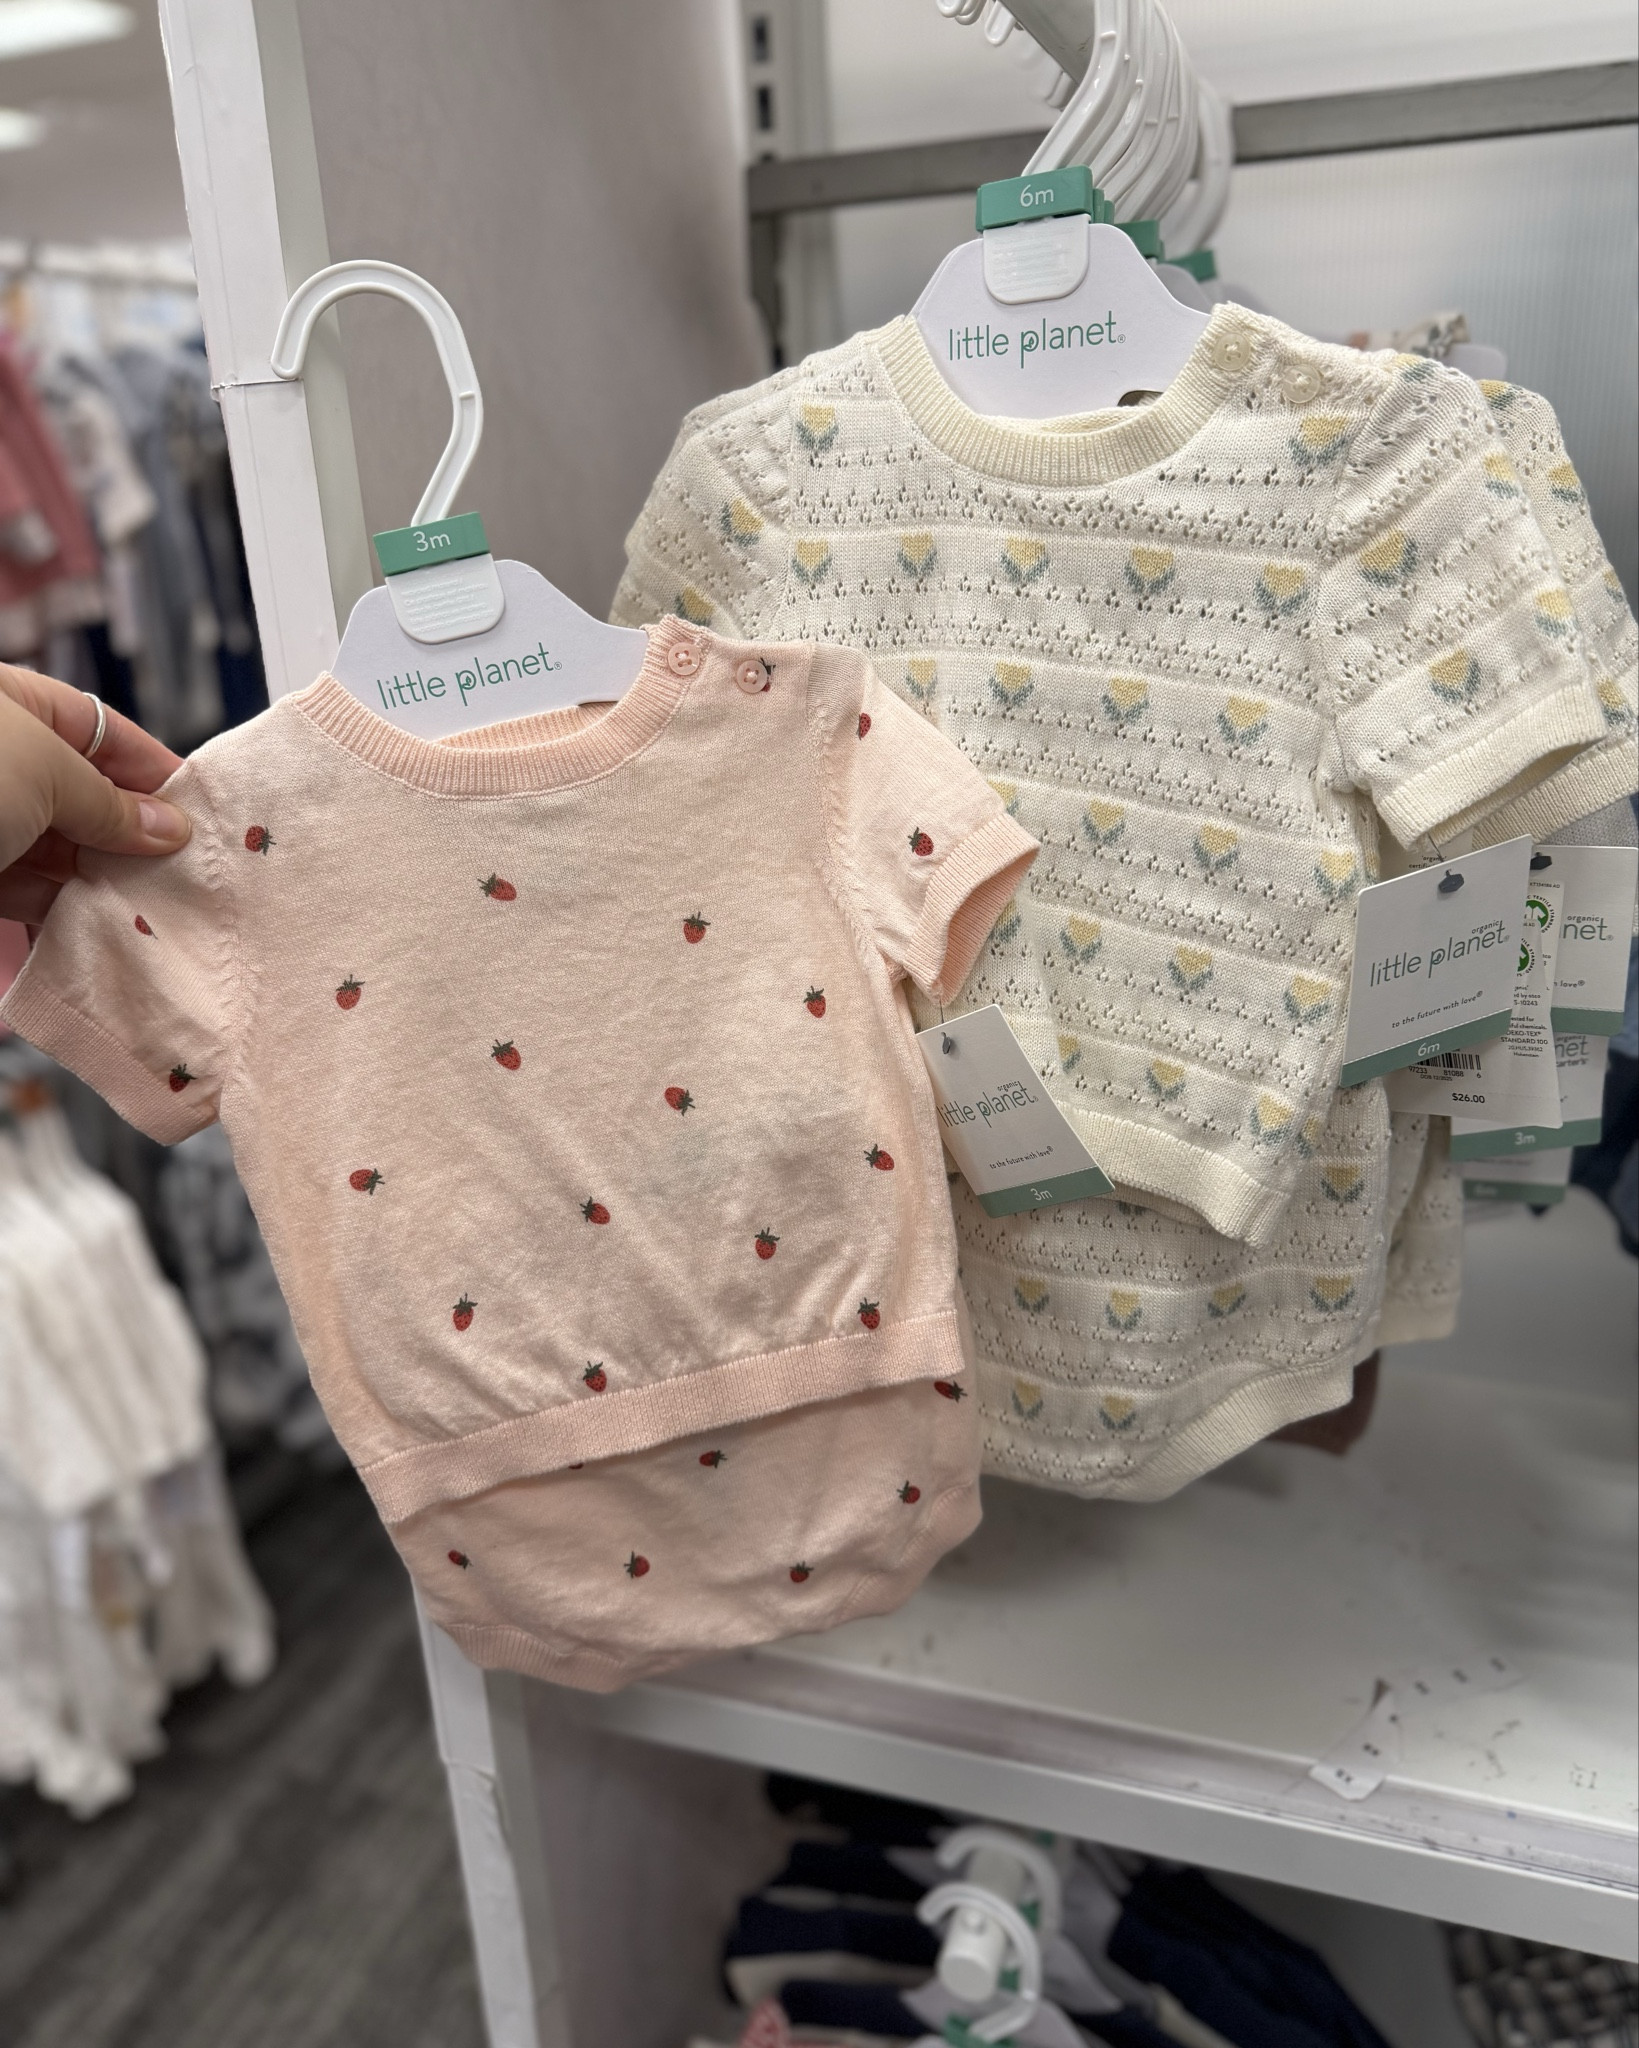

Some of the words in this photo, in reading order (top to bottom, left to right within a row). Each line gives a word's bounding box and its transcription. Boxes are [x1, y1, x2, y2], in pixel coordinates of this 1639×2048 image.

[1020, 184, 1054, 207] 6m
[949, 324, 1010, 361] little
[412, 531, 451, 552] 3m
[377, 670, 447, 710] little
[1471, 920, 1500, 934] organic
[1567, 915, 1600, 924] organic
[1370, 952, 1422, 988] little
[1402, 1016, 1415, 1025] the
[1417, 1008, 1441, 1020] future
[1443, 1001, 1460, 1011] with
[1500, 1036, 1536, 1045] STANDARD
[1418, 1042, 1440, 1056] 6m
[997, 1081, 1018, 1092] organic
[1452, 1092, 1485, 1103] $26.00
[936, 1100, 976, 1128] little
[1514, 1132, 1535, 1145] 3m
[997, 1160, 1006, 1168] the
[1006, 1157, 1025, 1165] future
[1024, 1151, 1037, 1161] with
[1030, 1188, 1053, 1201] 3m
